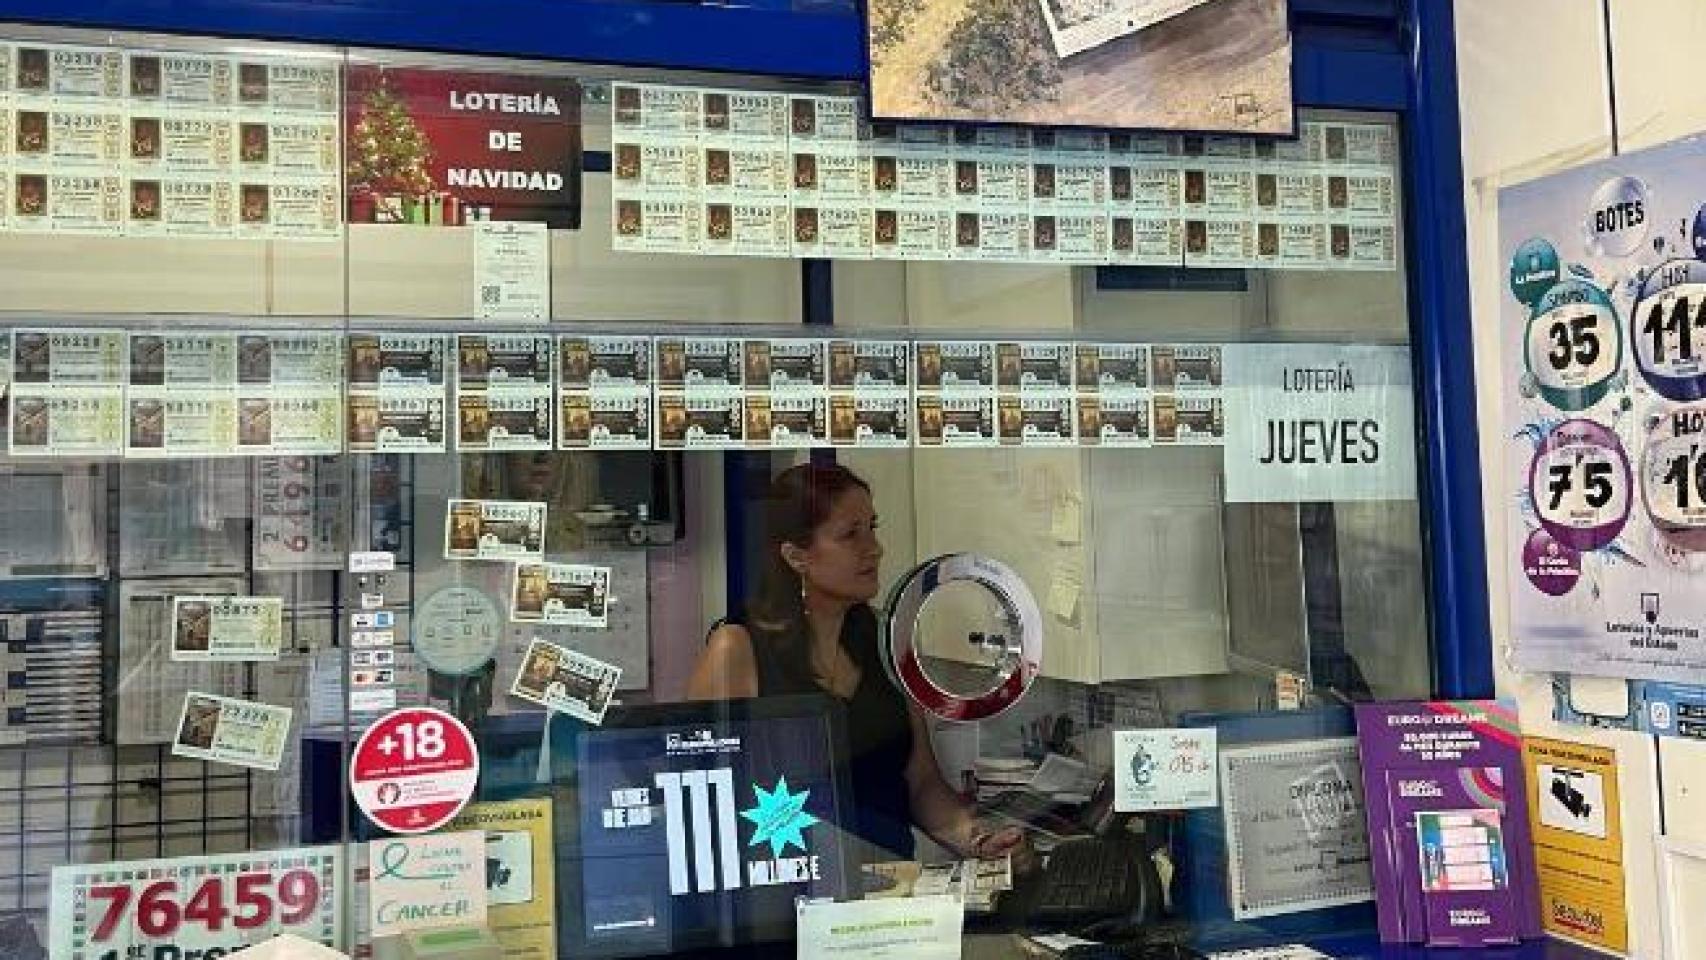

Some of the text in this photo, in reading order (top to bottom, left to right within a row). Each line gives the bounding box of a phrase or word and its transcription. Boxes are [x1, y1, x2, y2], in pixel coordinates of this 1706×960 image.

[450, 91, 560, 115] LOTERÍA
[489, 131, 522, 151] DE
[447, 168, 563, 191] NAVIDAD
[1596, 200, 1645, 233] BOTES
[1549, 314, 1600, 370] 35
[1283, 361, 1355, 393] LOTERÍA
[1259, 419, 1379, 464] JUEVES
[377, 720, 446, 761] +18
[655, 767, 741, 895] 111
[87, 867, 320, 943] 76459
